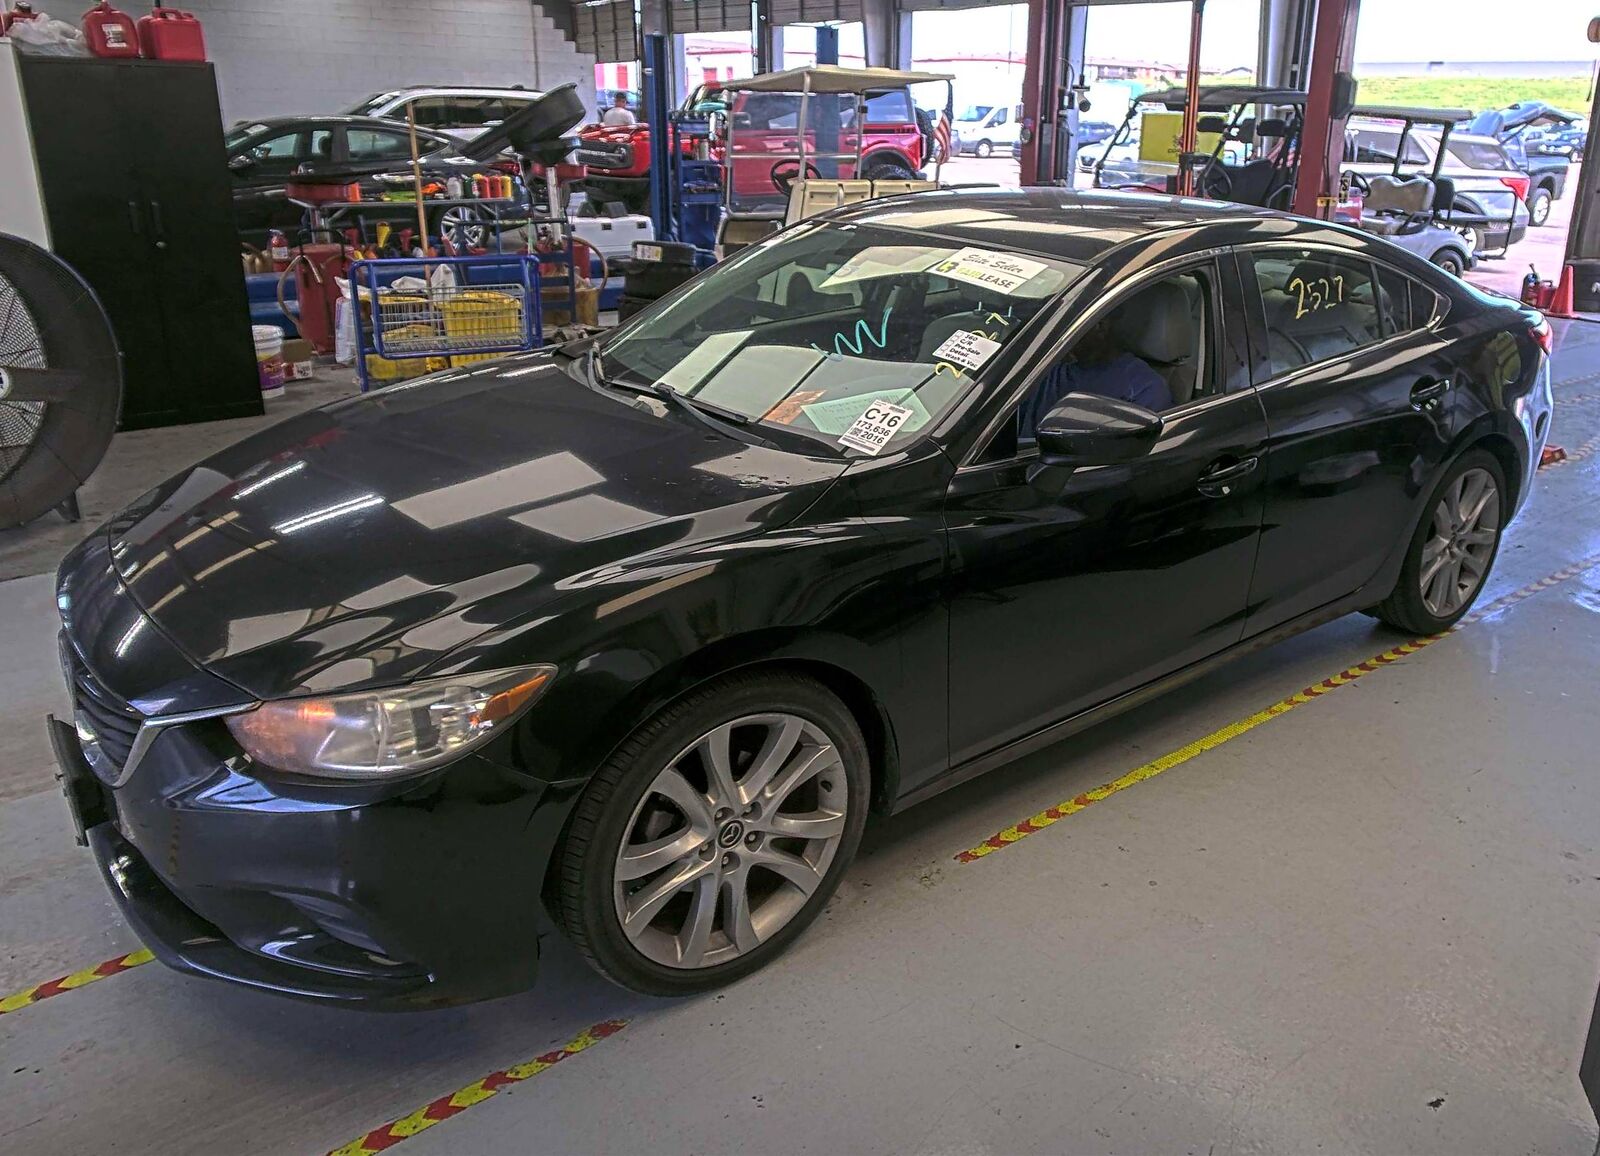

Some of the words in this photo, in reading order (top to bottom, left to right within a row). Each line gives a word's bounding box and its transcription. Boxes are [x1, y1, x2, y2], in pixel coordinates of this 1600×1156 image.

[1289, 275, 1344, 319] 2527
[949, 347, 971, 358] Detail
[954, 343, 981, 356] Pre-Sale
[945, 352, 960, 361] Wash
[864, 407, 902, 428] C16
[856, 419, 891, 437] 173,636
[860, 431, 885, 444] 2016
